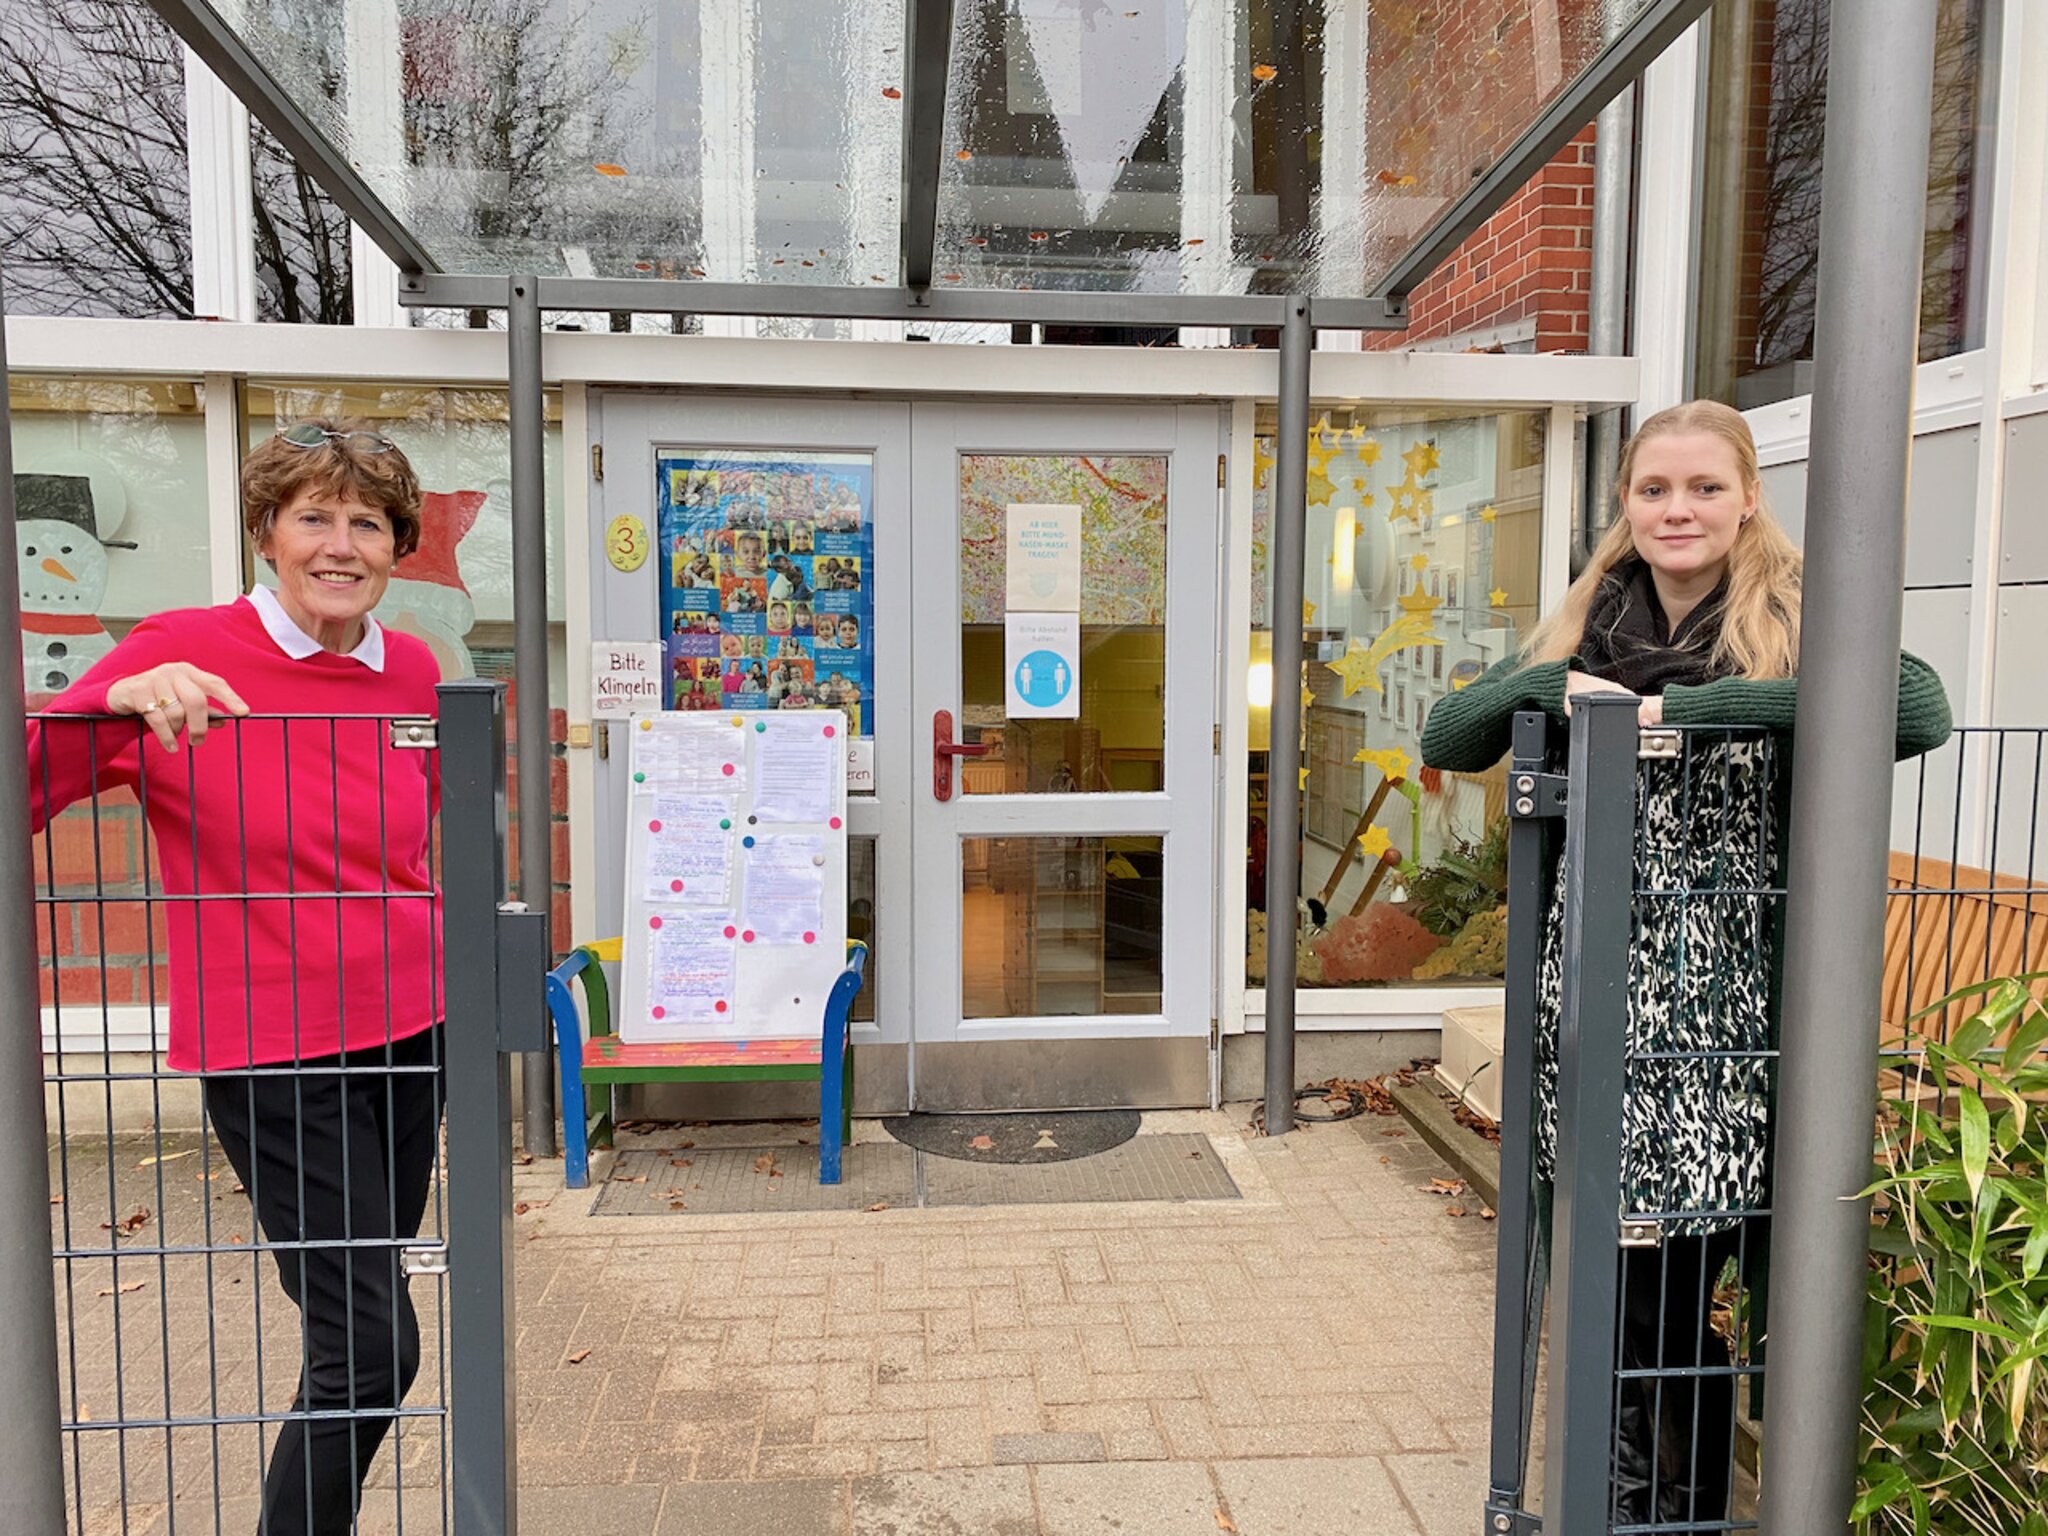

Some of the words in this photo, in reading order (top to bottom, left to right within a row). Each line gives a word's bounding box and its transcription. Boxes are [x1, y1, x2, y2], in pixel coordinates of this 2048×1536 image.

[617, 527, 634, 554] 3
[610, 652, 646, 671] Bitte
[598, 676, 656, 702] Klingeln
